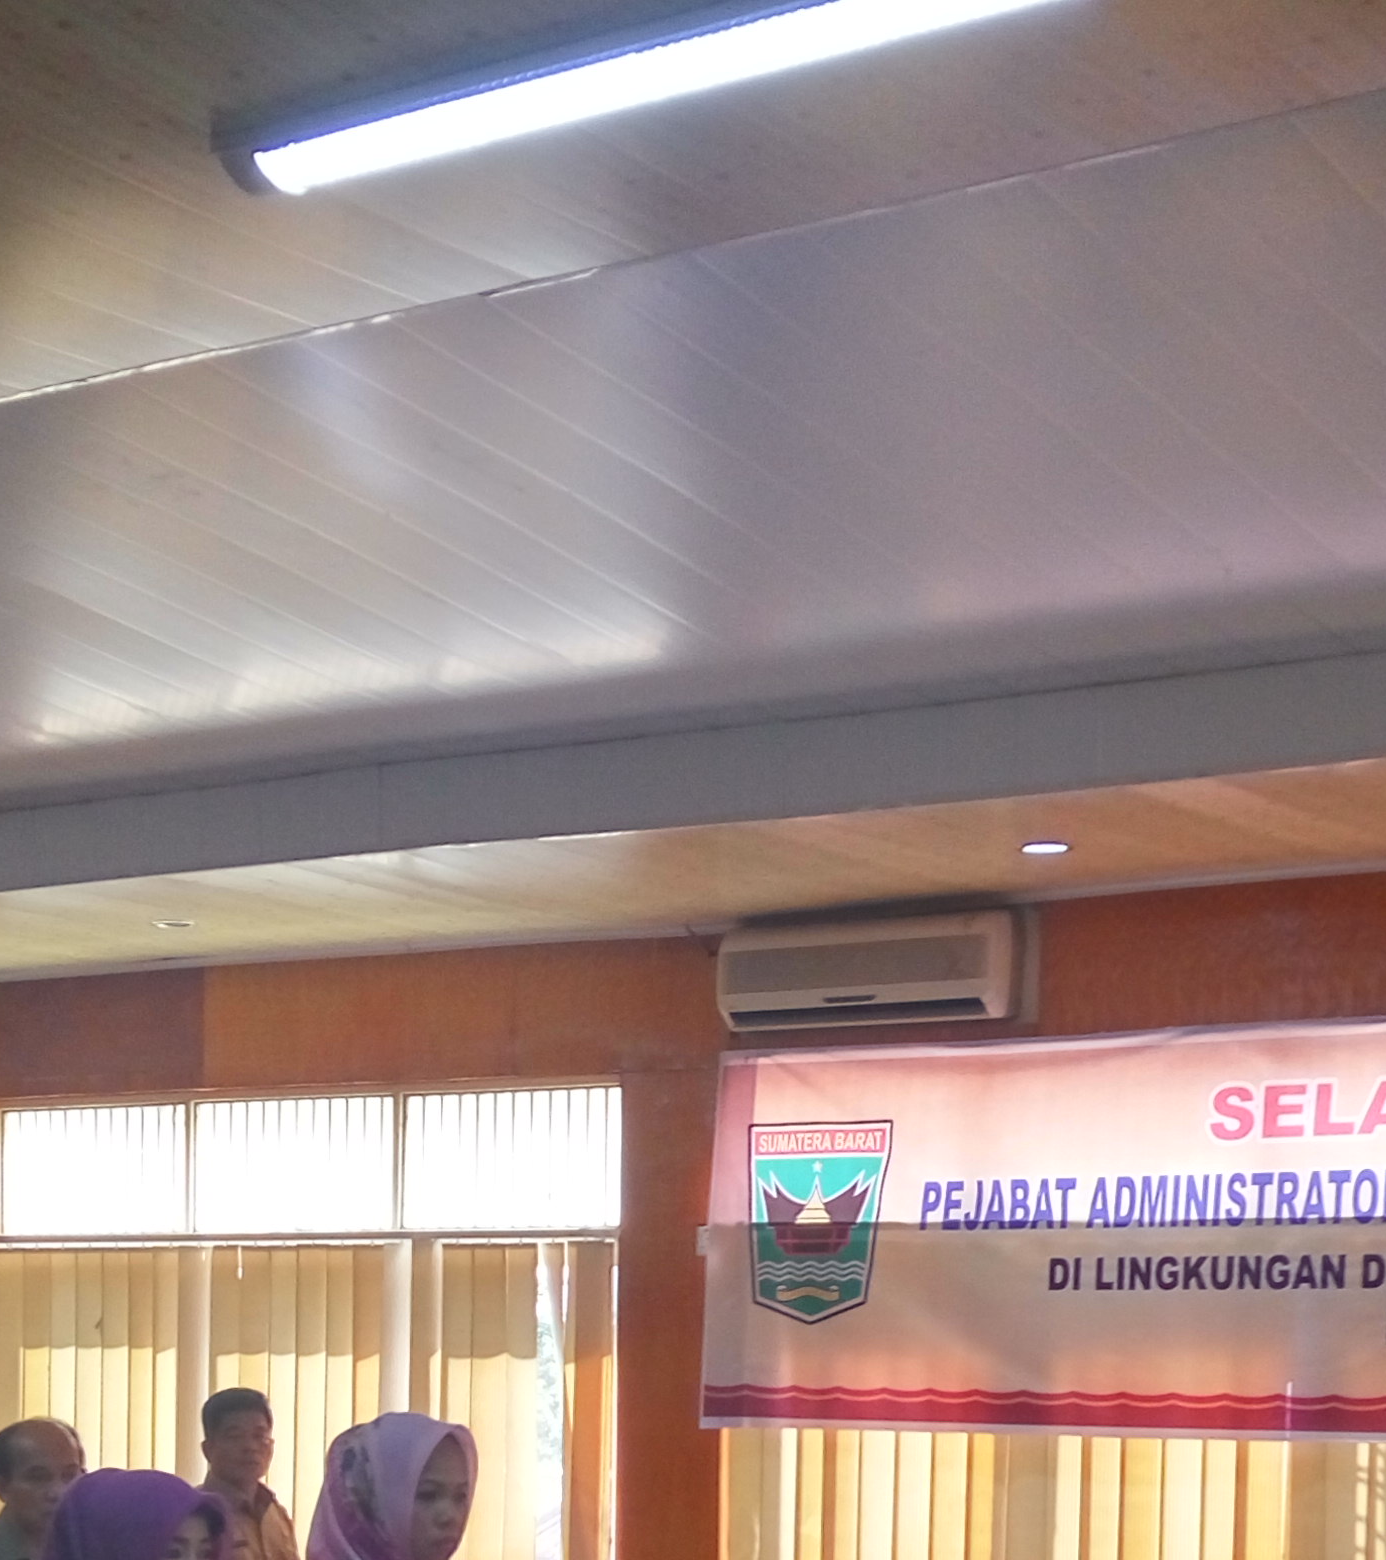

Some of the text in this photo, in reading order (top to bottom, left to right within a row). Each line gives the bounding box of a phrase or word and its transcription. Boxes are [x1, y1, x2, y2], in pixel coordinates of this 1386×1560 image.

[759, 1131, 882, 1152] SUMATERA BARAT
[919, 1178, 1077, 1230] PEJABAT
[1048, 1257, 1082, 1291] DI
[1095, 1254, 1346, 1291] LINGKUNGAN
